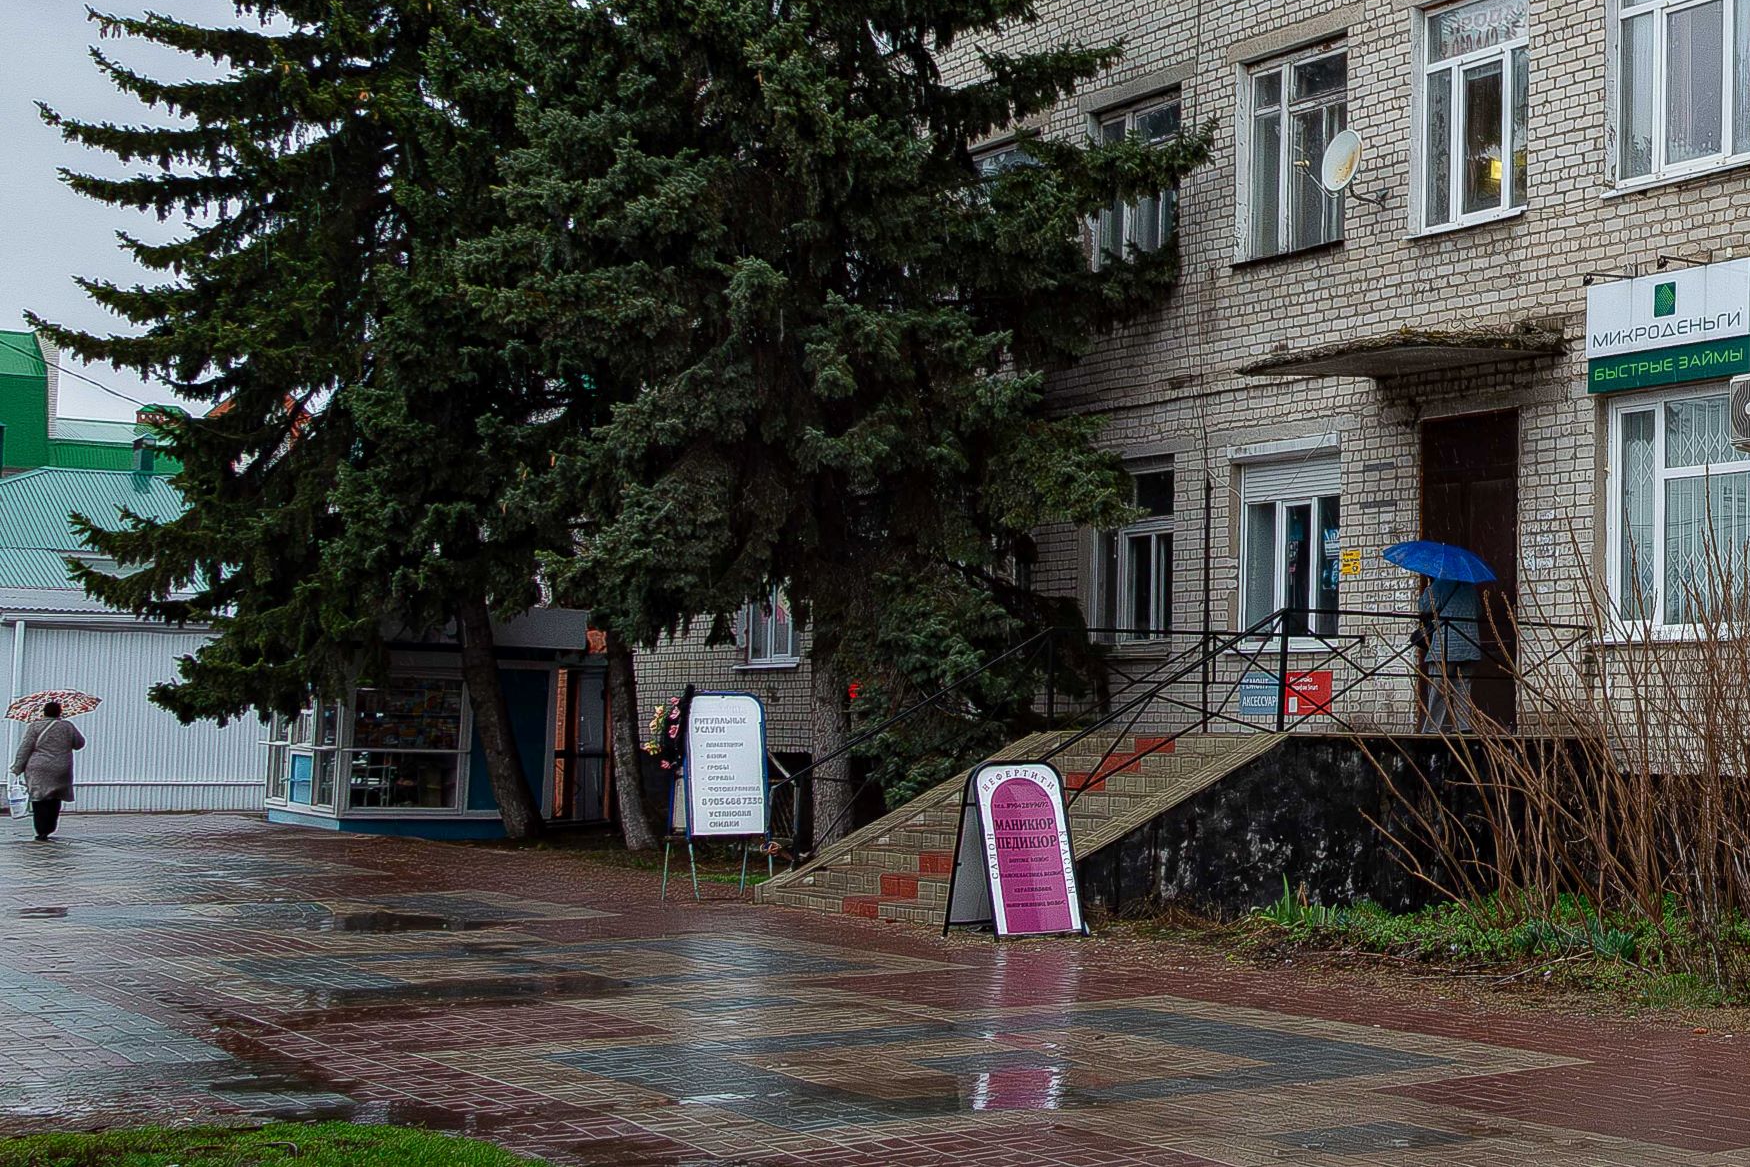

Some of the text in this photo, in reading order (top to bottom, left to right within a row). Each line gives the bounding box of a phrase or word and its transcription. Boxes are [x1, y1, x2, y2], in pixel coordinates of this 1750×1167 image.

[1592, 311, 1742, 349] МИКРОДЕНЬГИ
[1594, 348, 1744, 382] БЫСТРЫЕ ЗАЙМЫ
[1242, 695, 1278, 707] АКСЕССУАР
[694, 717, 747, 725] РИТУАЛЬНЫЕ
[694, 726, 726, 734] УСЛУГИ
[982, 769, 1055, 792] НЕФЕРТИТИ
[994, 817, 1054, 831] МАНИКЮР
[996, 834, 1057, 851] ПЕДИКЮР
[986, 833, 999, 880] САЛОН
[1059, 830, 1076, 894] КРАСОТЫ
